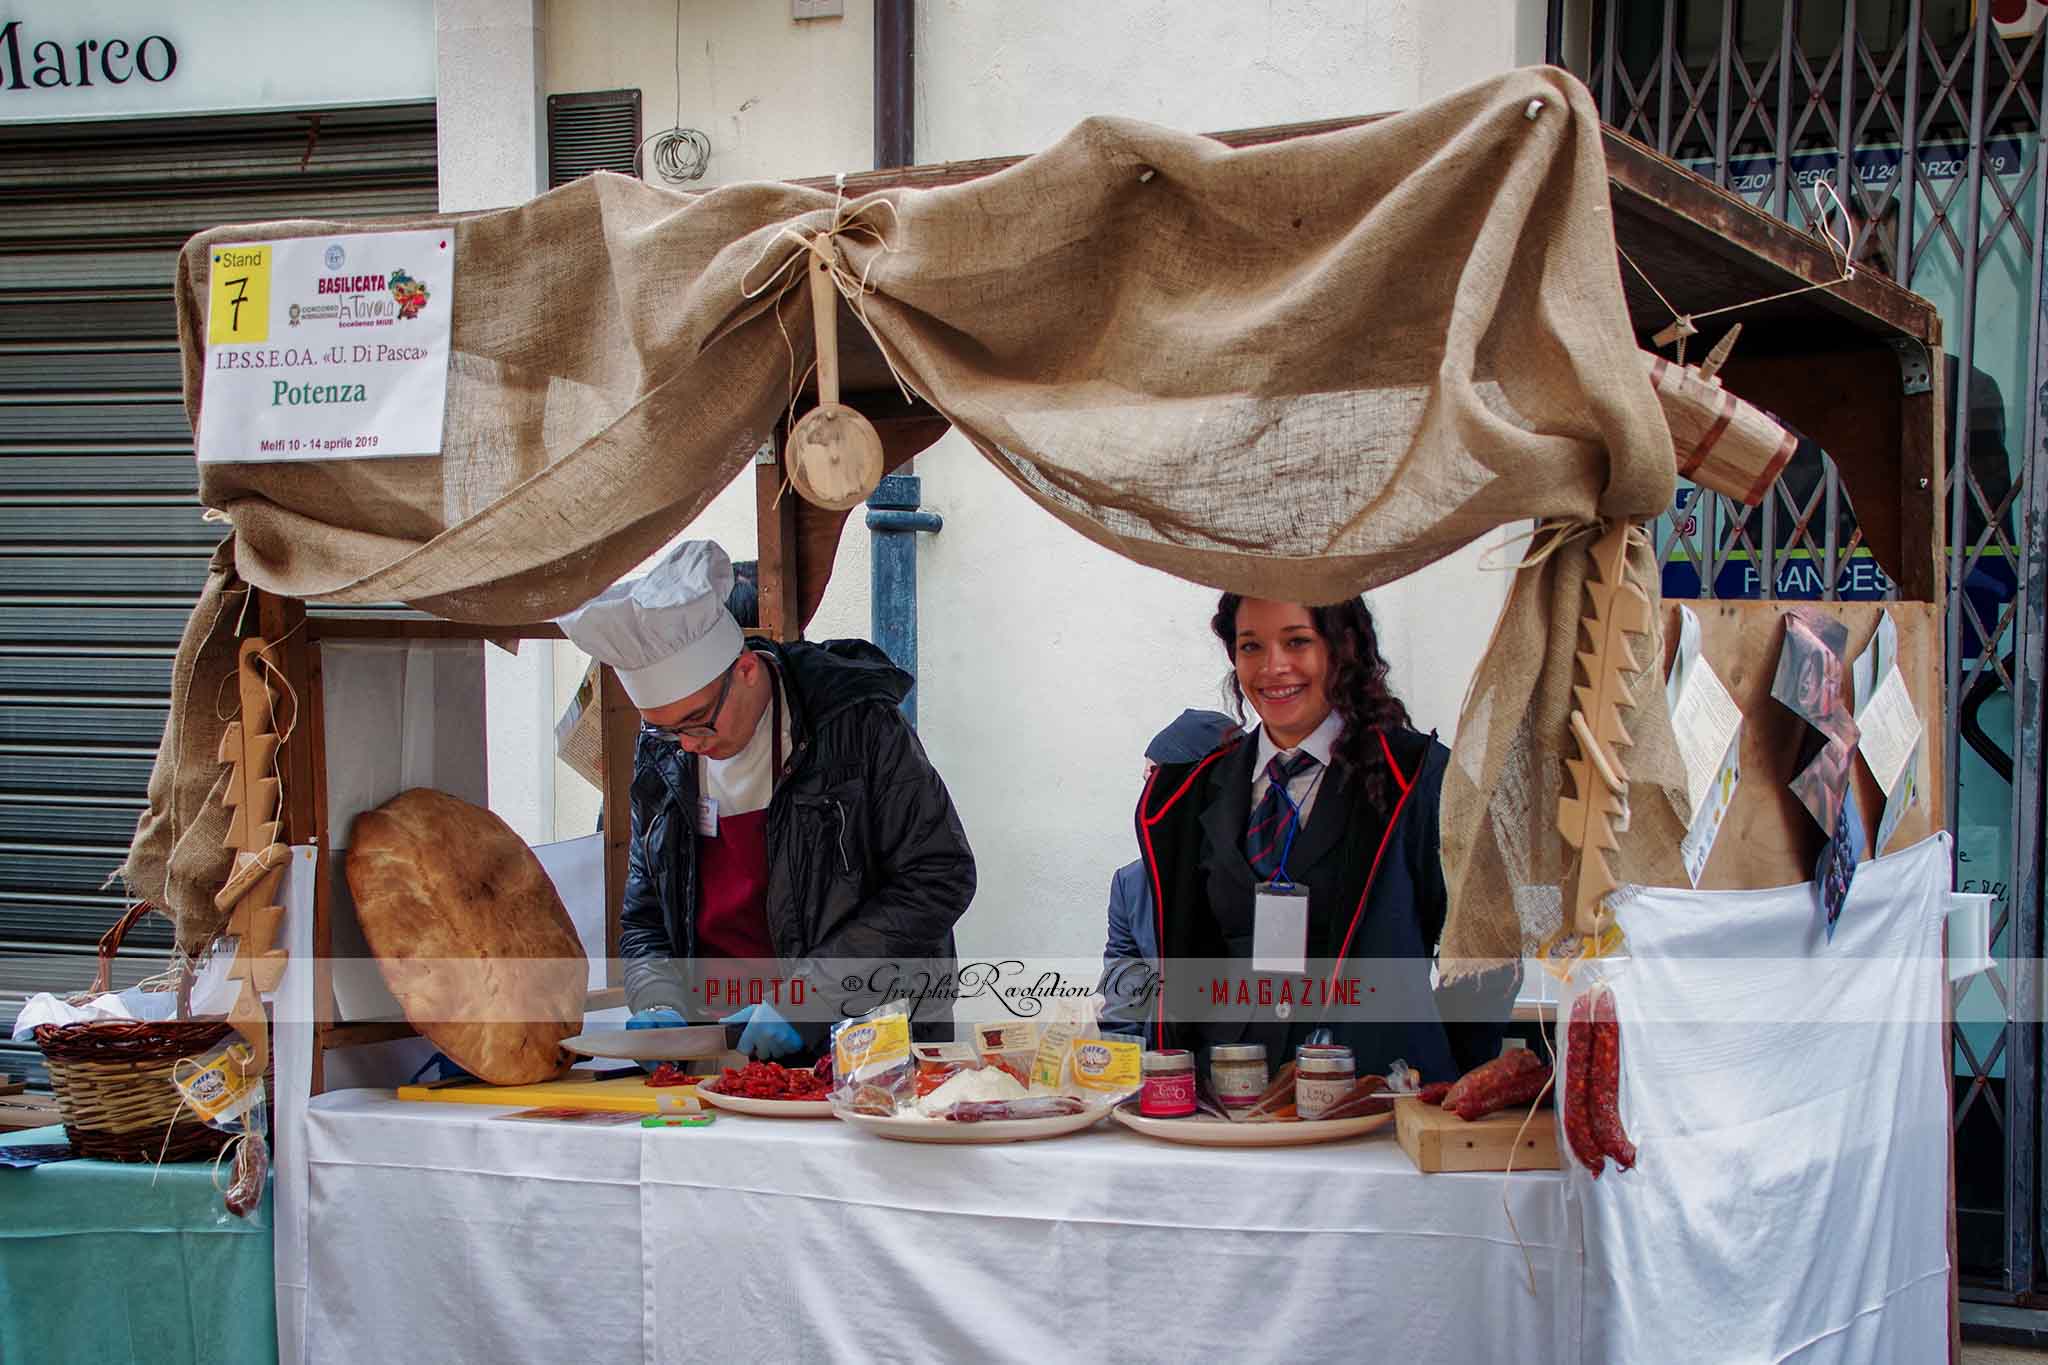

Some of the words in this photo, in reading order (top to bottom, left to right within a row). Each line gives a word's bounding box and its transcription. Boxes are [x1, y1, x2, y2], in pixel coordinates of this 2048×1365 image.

[0, 21, 177, 90] Marco
[223, 251, 262, 268] Stand
[317, 275, 385, 294] BASILICATA
[224, 277, 249, 331] 7
[216, 350, 318, 369] I.P.S.S.E.O.A.
[353, 345, 371, 362] Di
[376, 344, 428, 362] Pasca»
[272, 380, 367, 407] Potenza
[260, 439, 285, 452] Melfi
[289, 438, 300, 451] 10
[309, 438, 321, 450] 14
[324, 437, 352, 451] aprile
[355, 435, 379, 448] 2019
